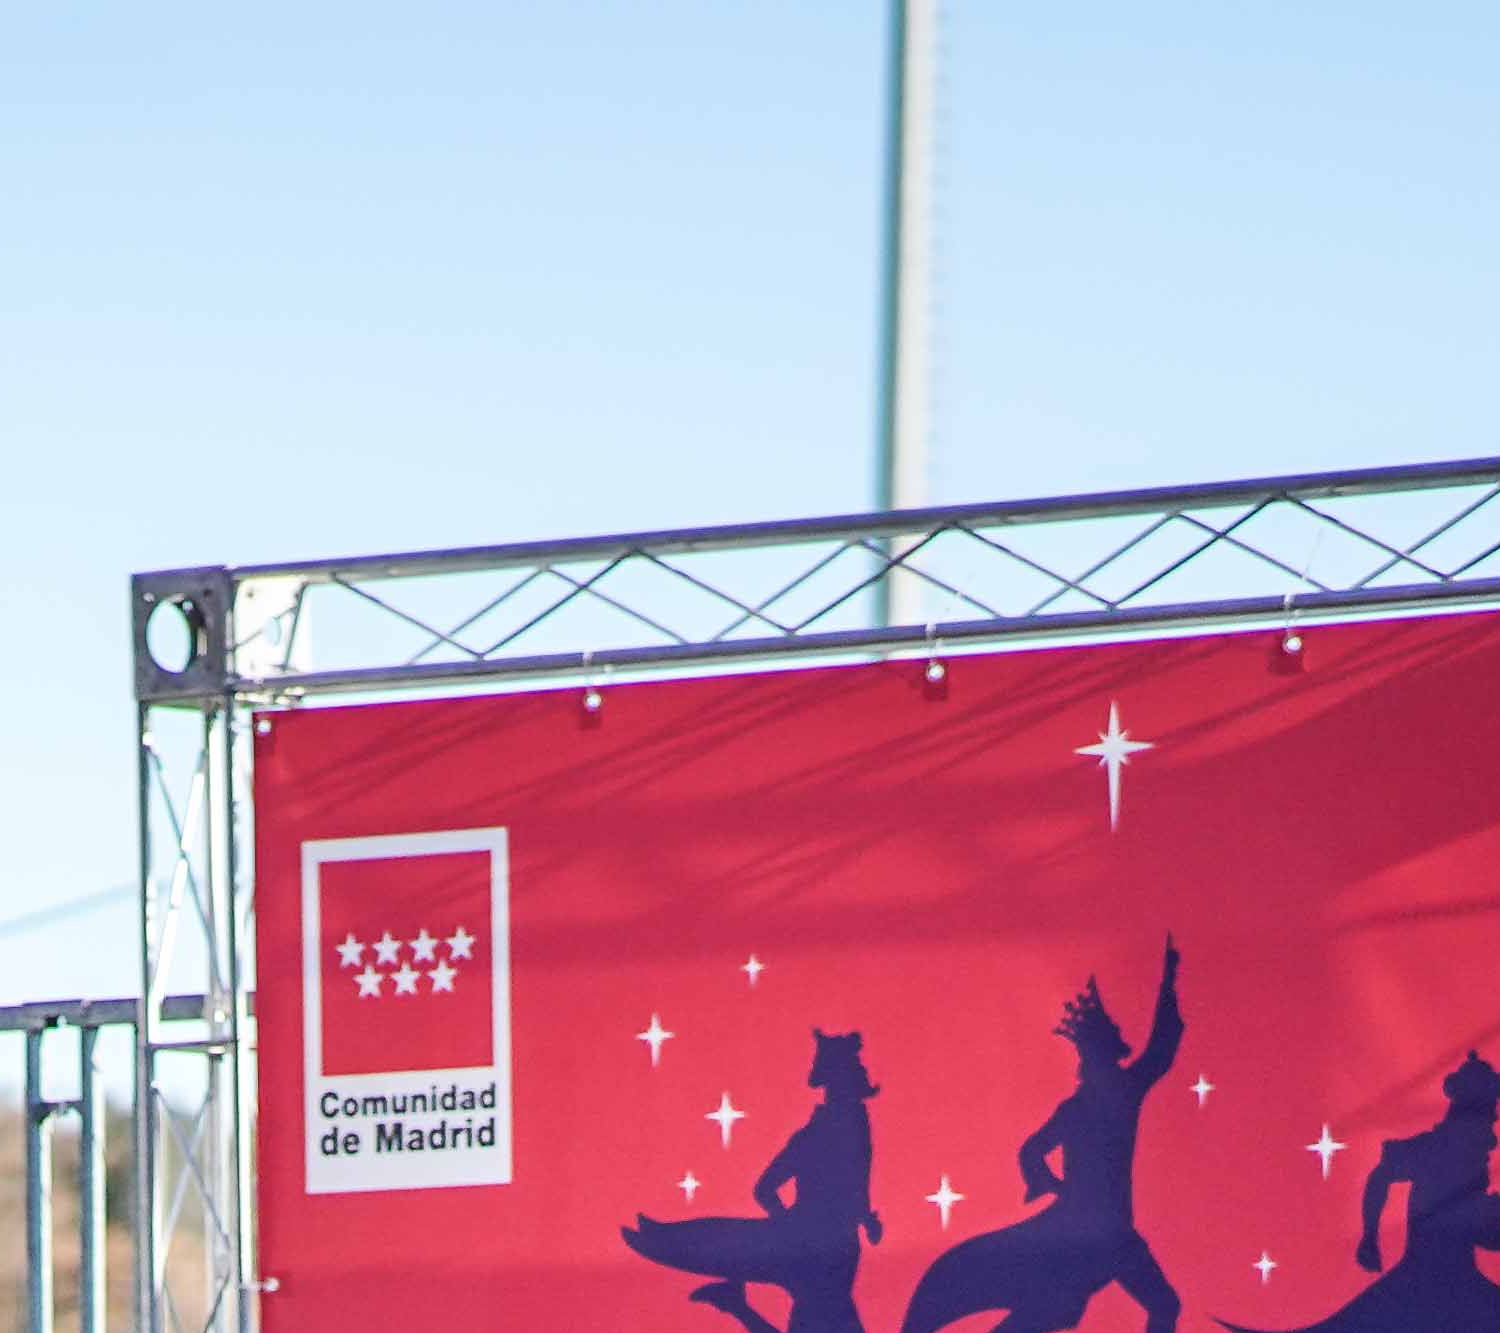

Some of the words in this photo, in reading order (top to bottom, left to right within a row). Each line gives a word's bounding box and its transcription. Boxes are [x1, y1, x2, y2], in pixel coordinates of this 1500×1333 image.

[320, 1080, 497, 1119] Comunidad
[320, 1126, 361, 1156] de
[374, 1117, 496, 1153] Madrid
